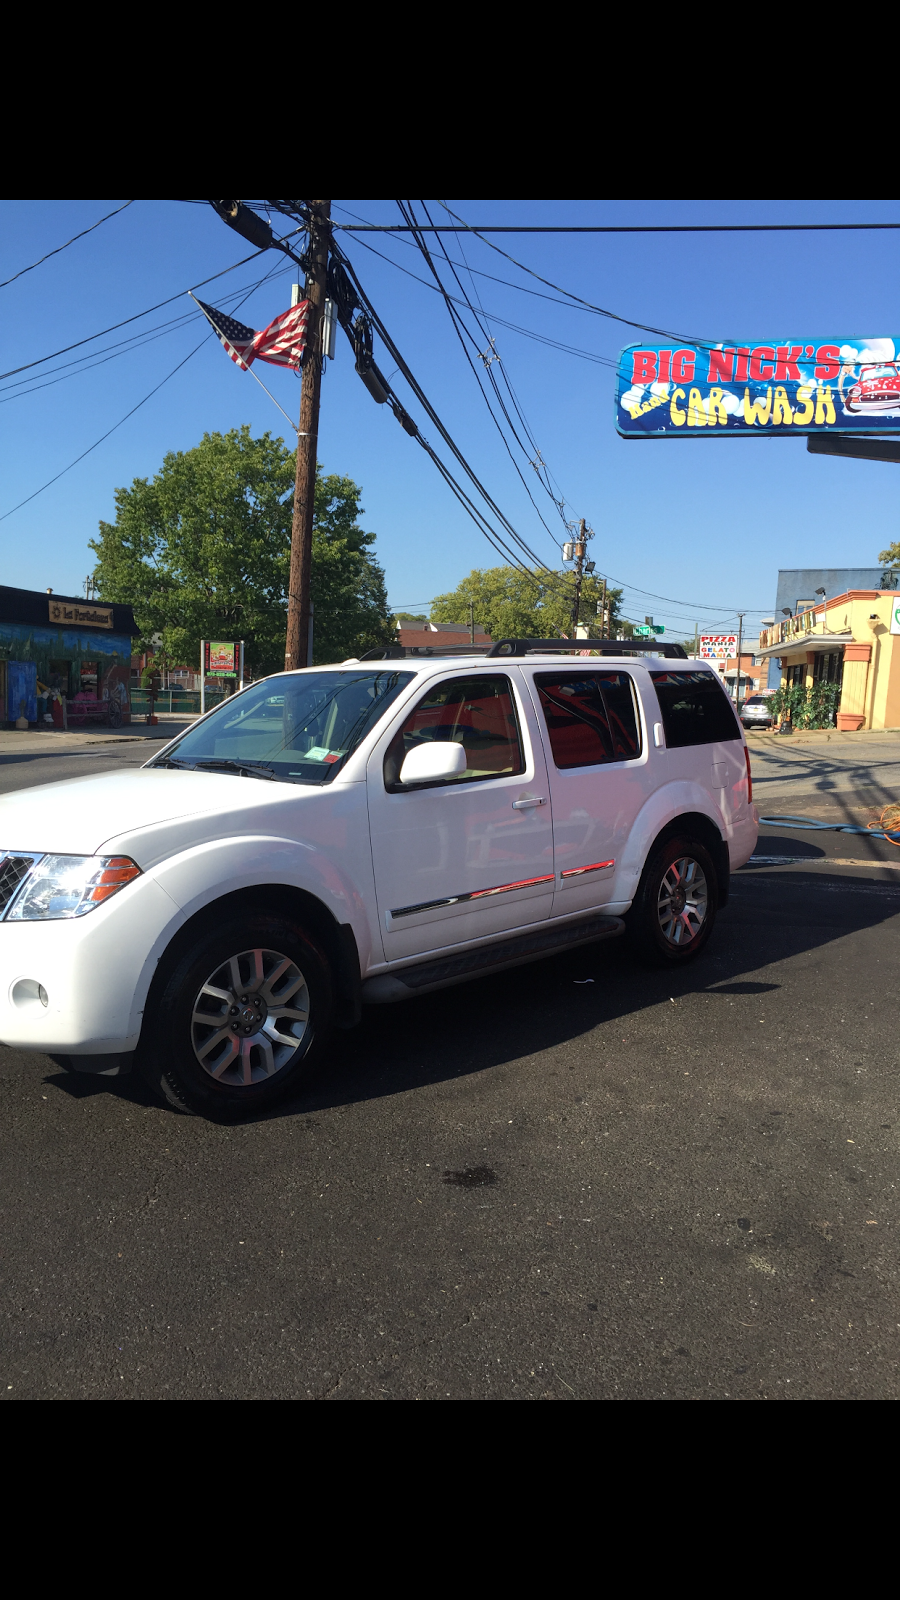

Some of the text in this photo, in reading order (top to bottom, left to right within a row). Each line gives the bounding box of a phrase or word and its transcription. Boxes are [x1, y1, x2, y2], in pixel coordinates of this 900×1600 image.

[631, 344, 841, 385] BIG NICK'S
[628, 385, 837, 426] Hand CAR WASH
[634, 626, 658, 635] Charles
